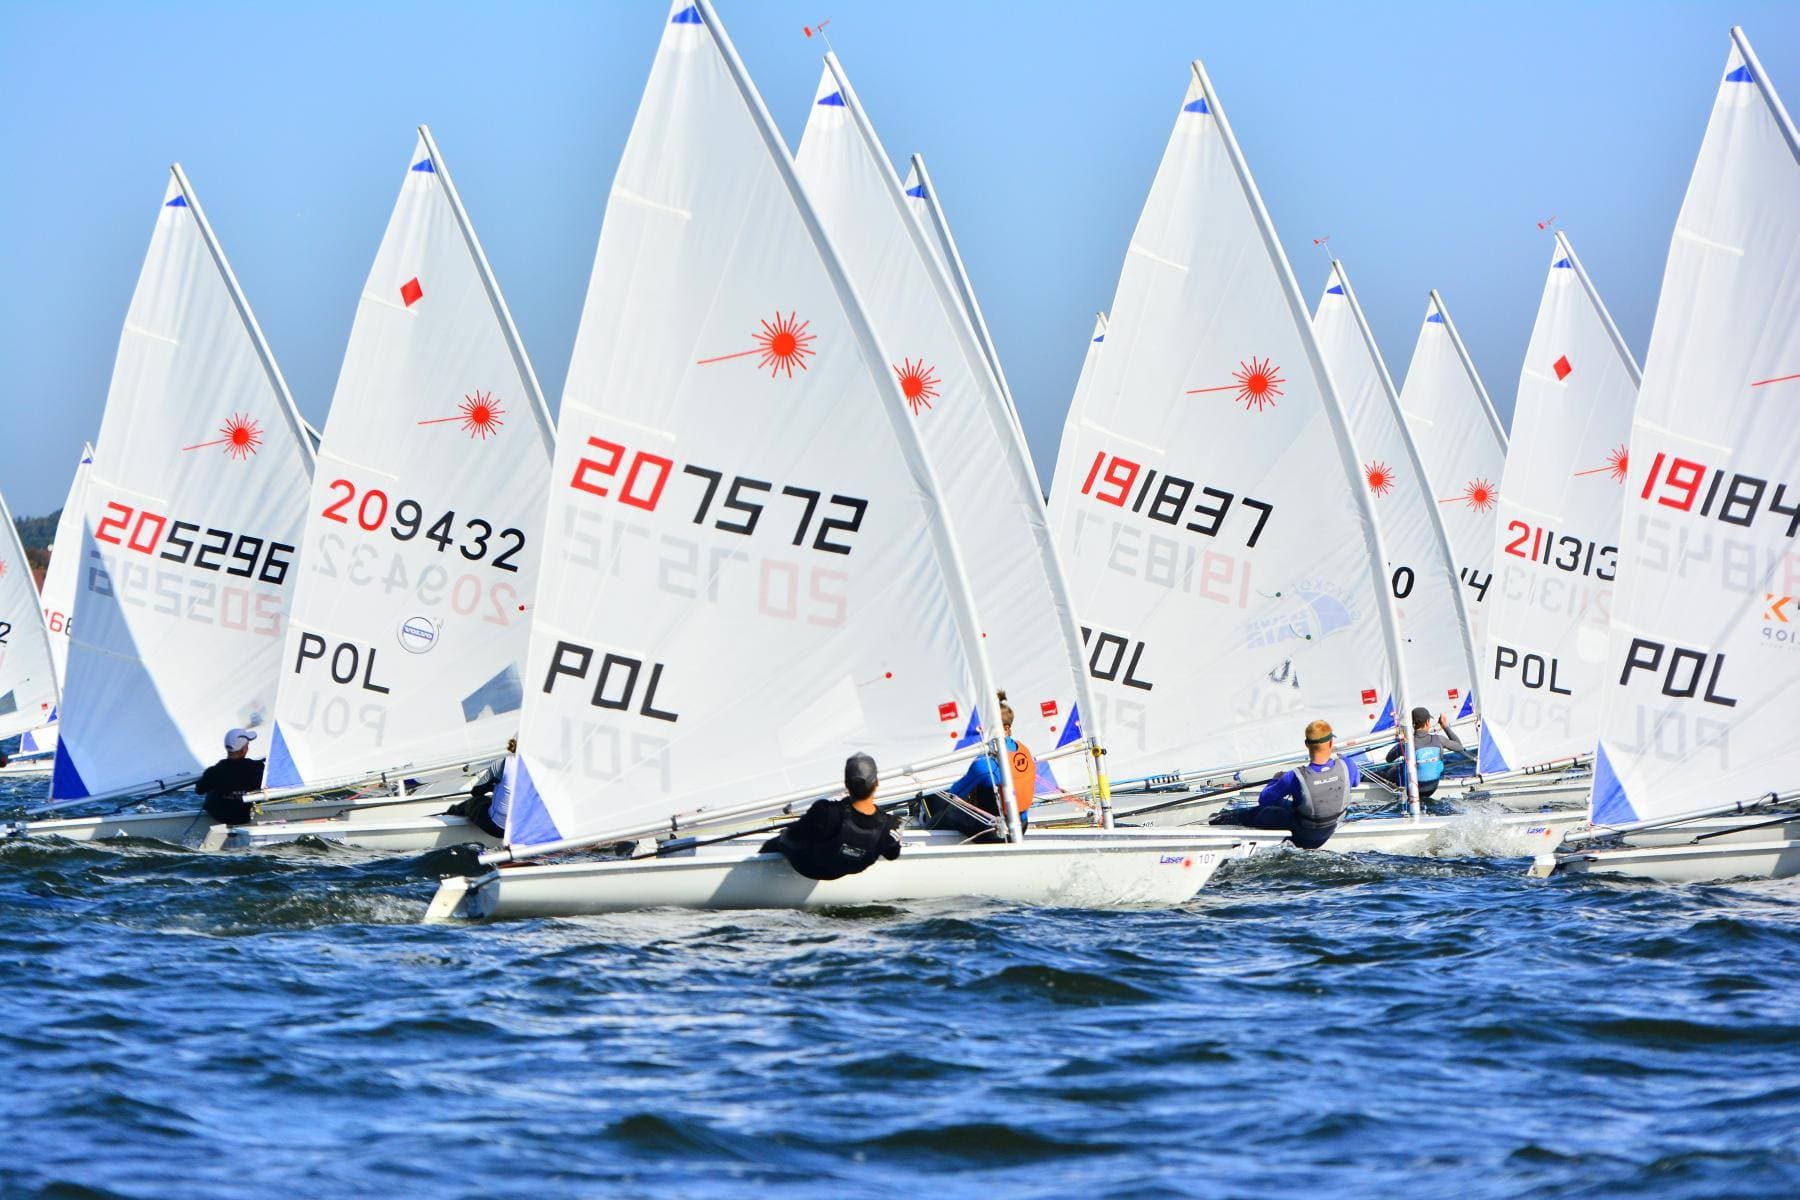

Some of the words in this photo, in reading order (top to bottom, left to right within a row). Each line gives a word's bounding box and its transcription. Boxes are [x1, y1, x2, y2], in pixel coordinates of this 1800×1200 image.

[321, 479, 526, 573] 209432
[570, 437, 869, 555] 207572
[1081, 451, 1274, 548] 191837
[95, 501, 295, 585] 205296
[1505, 520, 1617, 581] 211313
[1387, 561, 1415, 599] 0
[295, 632, 390, 694] POL
[543, 640, 678, 722] POL
[1080, 626, 1153, 691] OL
[1495, 646, 1572, 696] POL
[1620, 638, 1737, 707] POL
[1160, 855, 1184, 864] Laser
